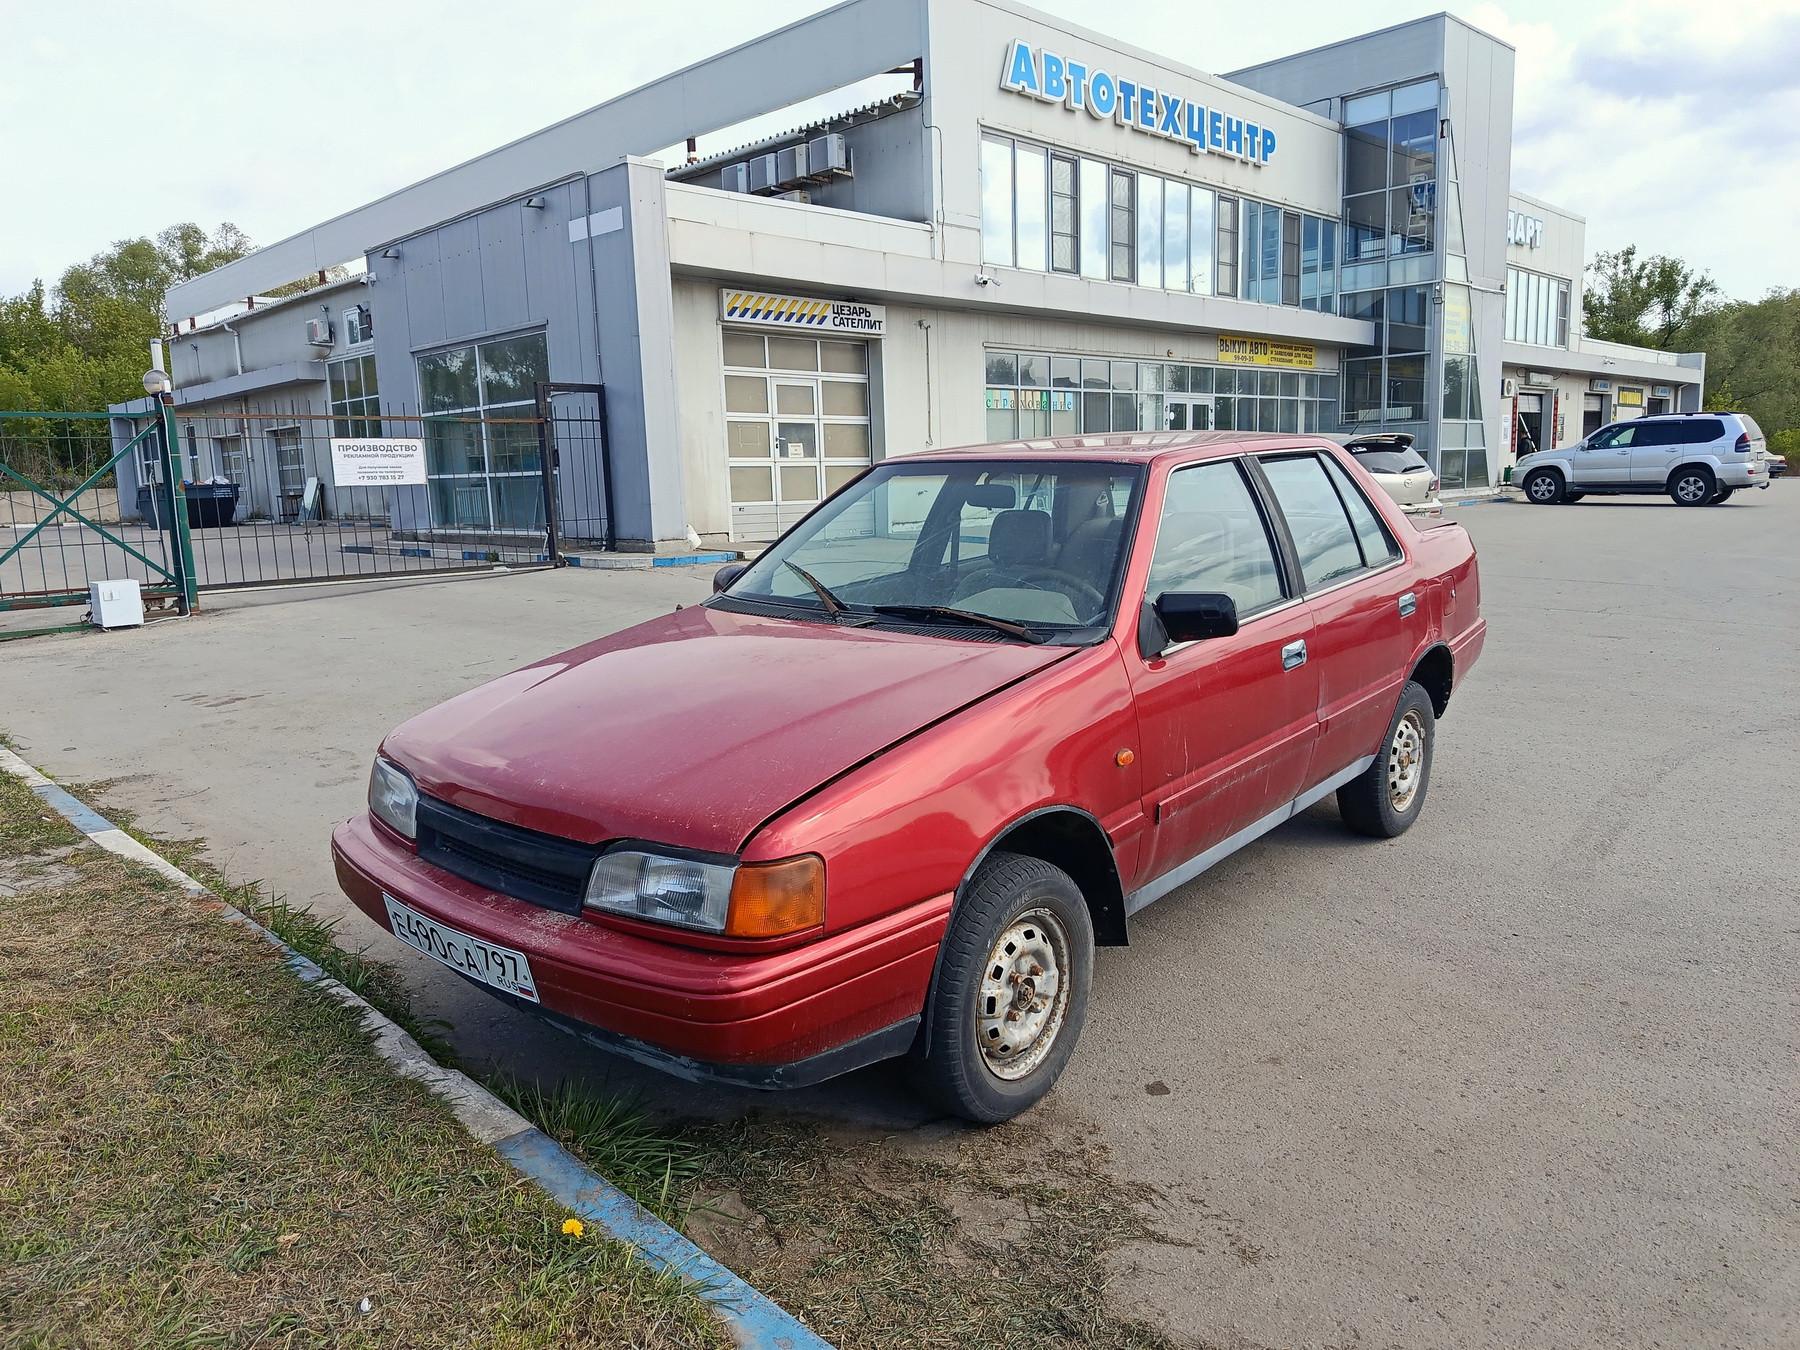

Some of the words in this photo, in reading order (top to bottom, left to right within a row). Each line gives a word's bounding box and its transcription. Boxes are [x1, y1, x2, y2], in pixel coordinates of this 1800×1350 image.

[1001, 38, 1277, 166] АВТОТЕХЦЕНТР
[832, 303, 872, 318] ЦЕЗАРЬ
[832, 315, 883, 331] САТЕЛЛИТ
[1219, 338, 1247, 354] ВЫКУП
[1248, 341, 1268, 356] АВТО
[1233, 354, 1254, 363] 99-09-35
[986, 398, 1072, 411] страхование
[338, 444, 418, 453] ПРОИЗВОДСТВО
[497, 976, 518, 991] RUS
